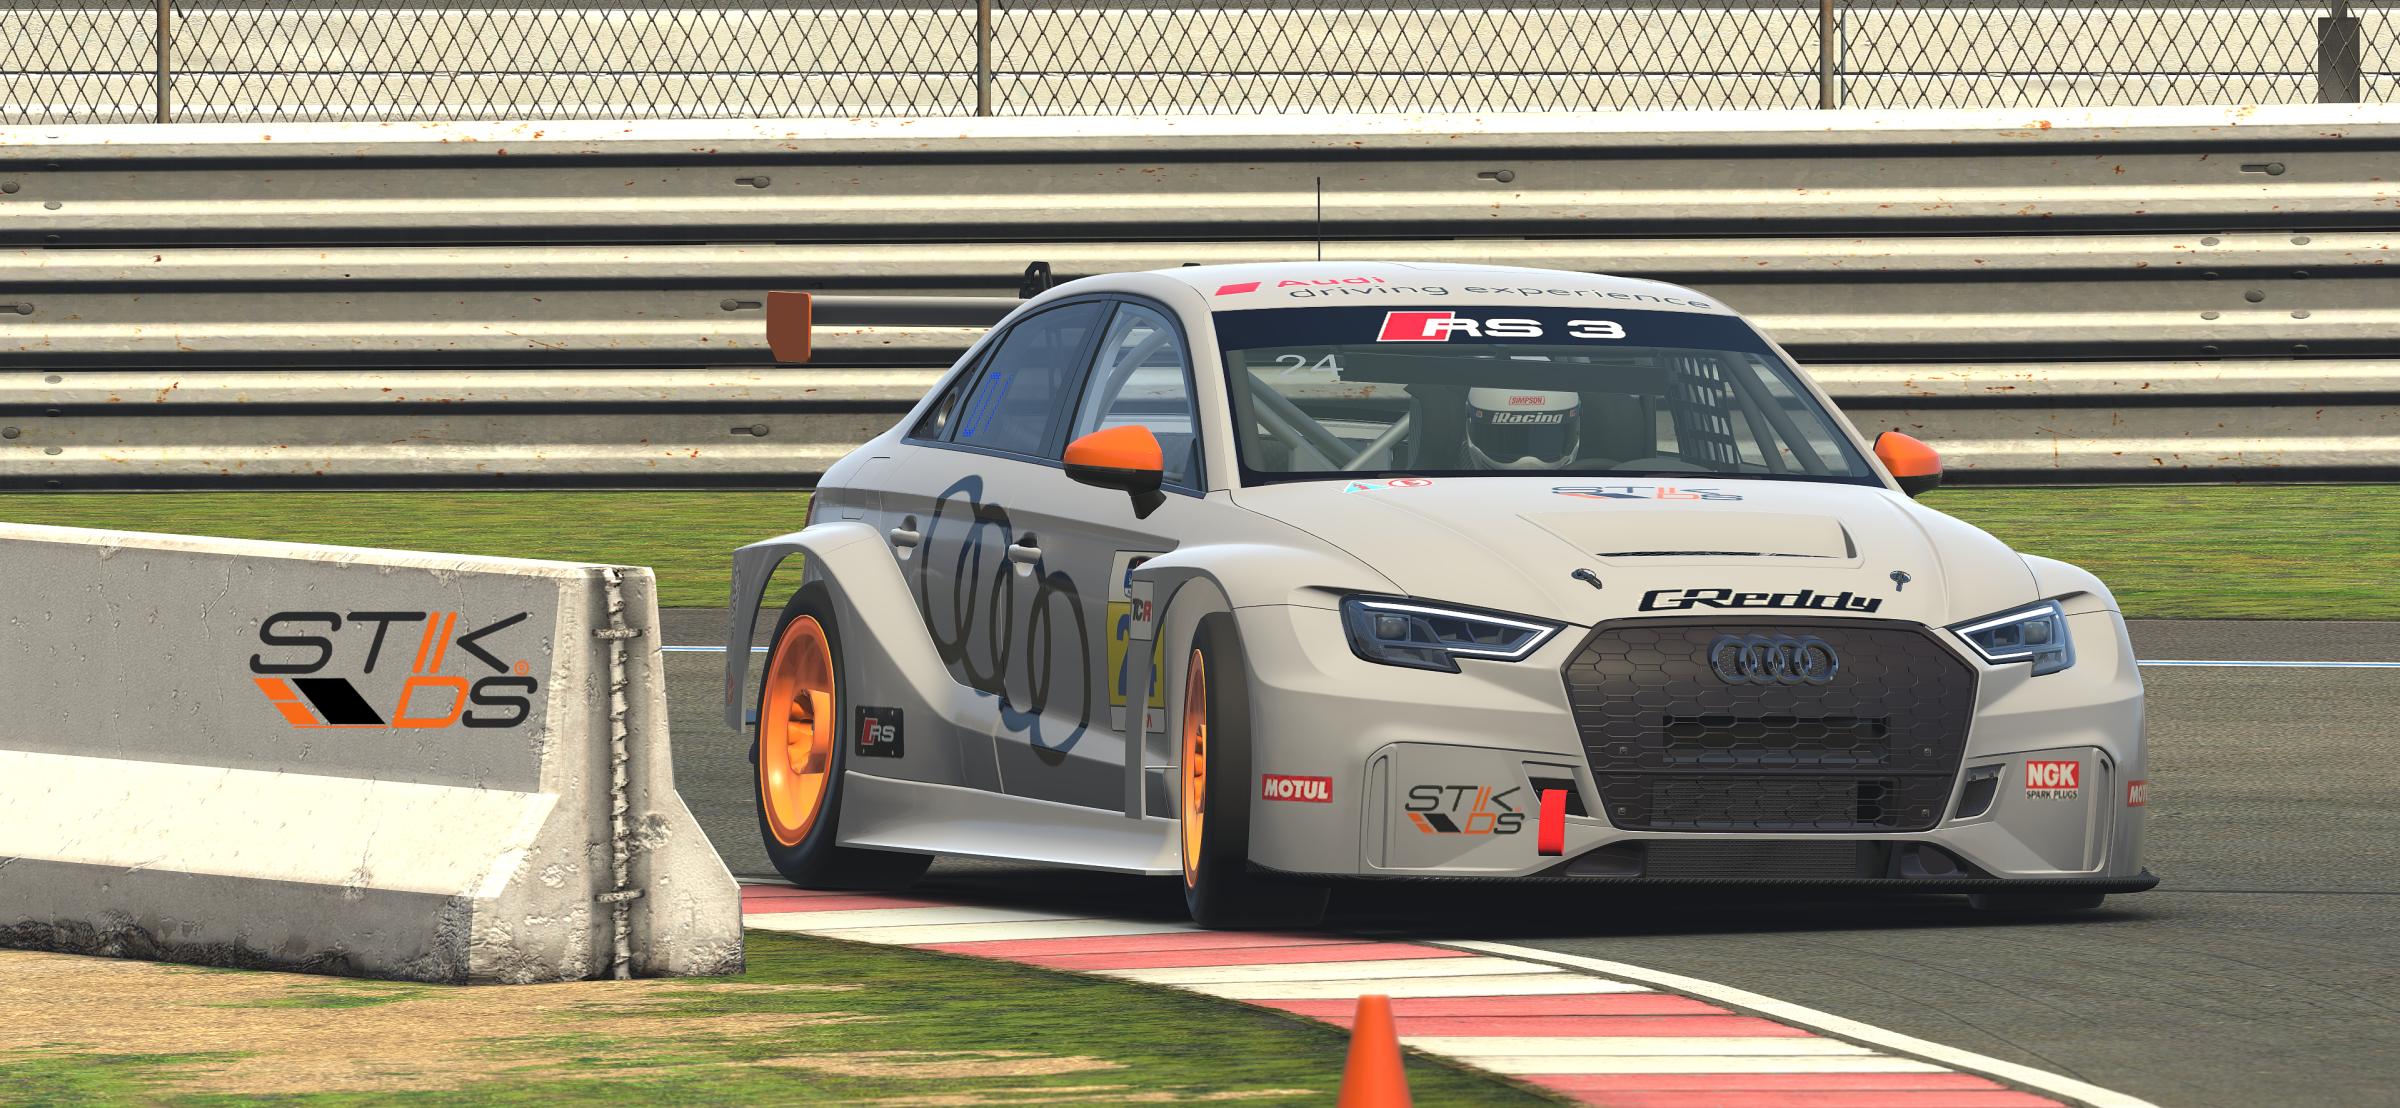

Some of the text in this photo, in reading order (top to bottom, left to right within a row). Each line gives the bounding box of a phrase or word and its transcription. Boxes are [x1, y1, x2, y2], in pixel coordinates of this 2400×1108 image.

[1277, 276, 1386, 288] Audi
[1289, 285, 1712, 309] driving experience
[1421, 317, 1627, 339] RS 3
[1275, 354, 1344, 378] 24
[1491, 412, 1564, 425] iRacing
[1132, 598, 1152, 622] TCR
[1638, 588, 1883, 613] GReddy
[868, 724, 896, 742] RS
[2027, 762, 2076, 787] NGK
[1264, 778, 1329, 800] MOTUL
[2026, 790, 2078, 799] SPARK PLUGS
